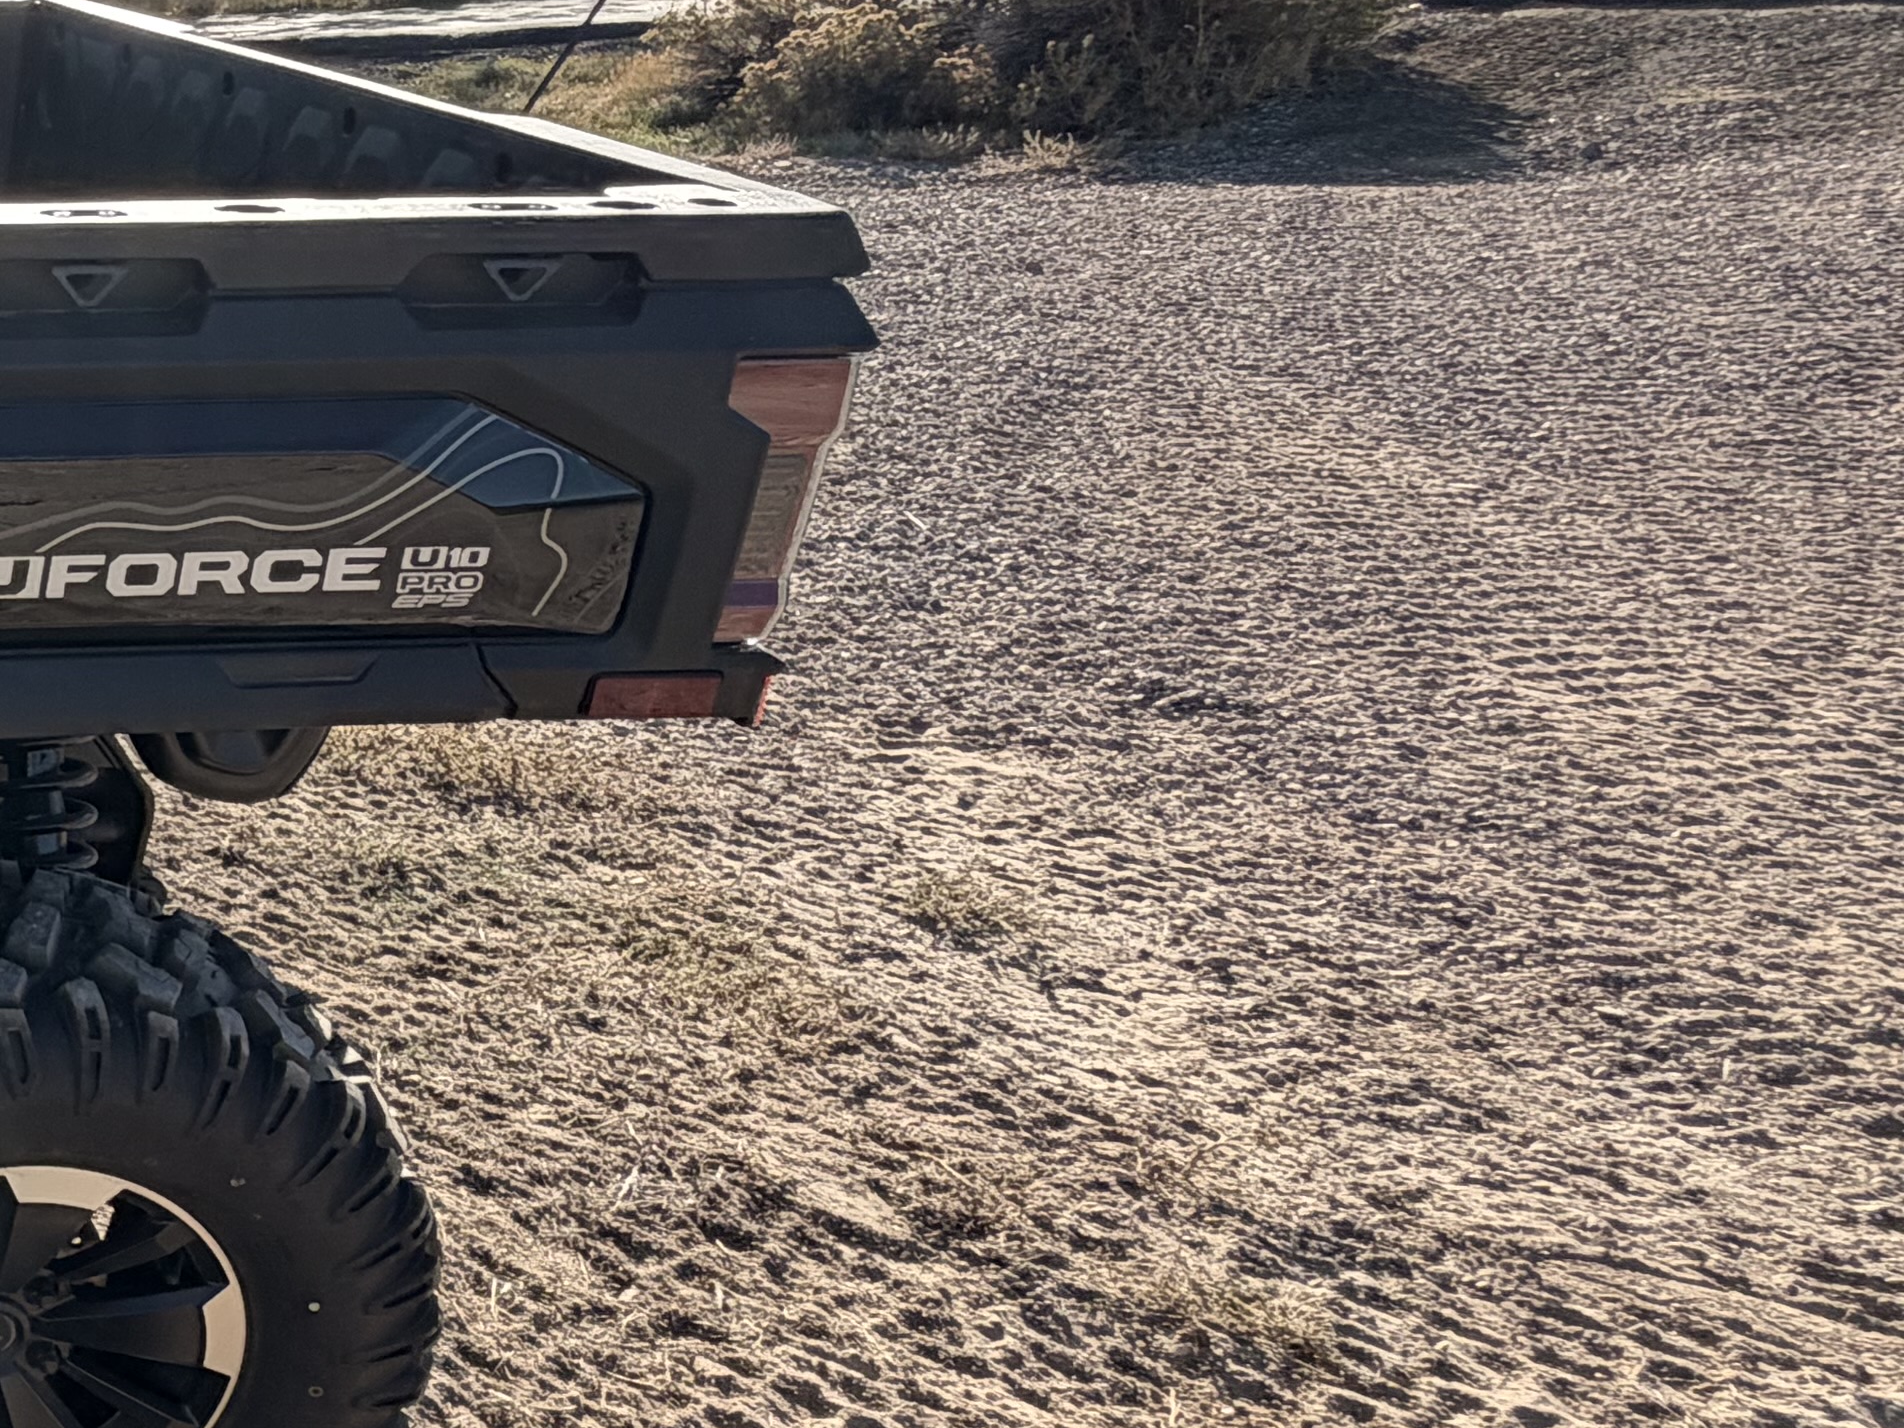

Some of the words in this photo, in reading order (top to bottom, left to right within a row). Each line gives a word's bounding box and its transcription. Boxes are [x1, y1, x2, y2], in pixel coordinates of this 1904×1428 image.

[400, 546, 491, 570] U10
[395, 571, 484, 594] PRO
[391, 593, 475, 609] EPS
